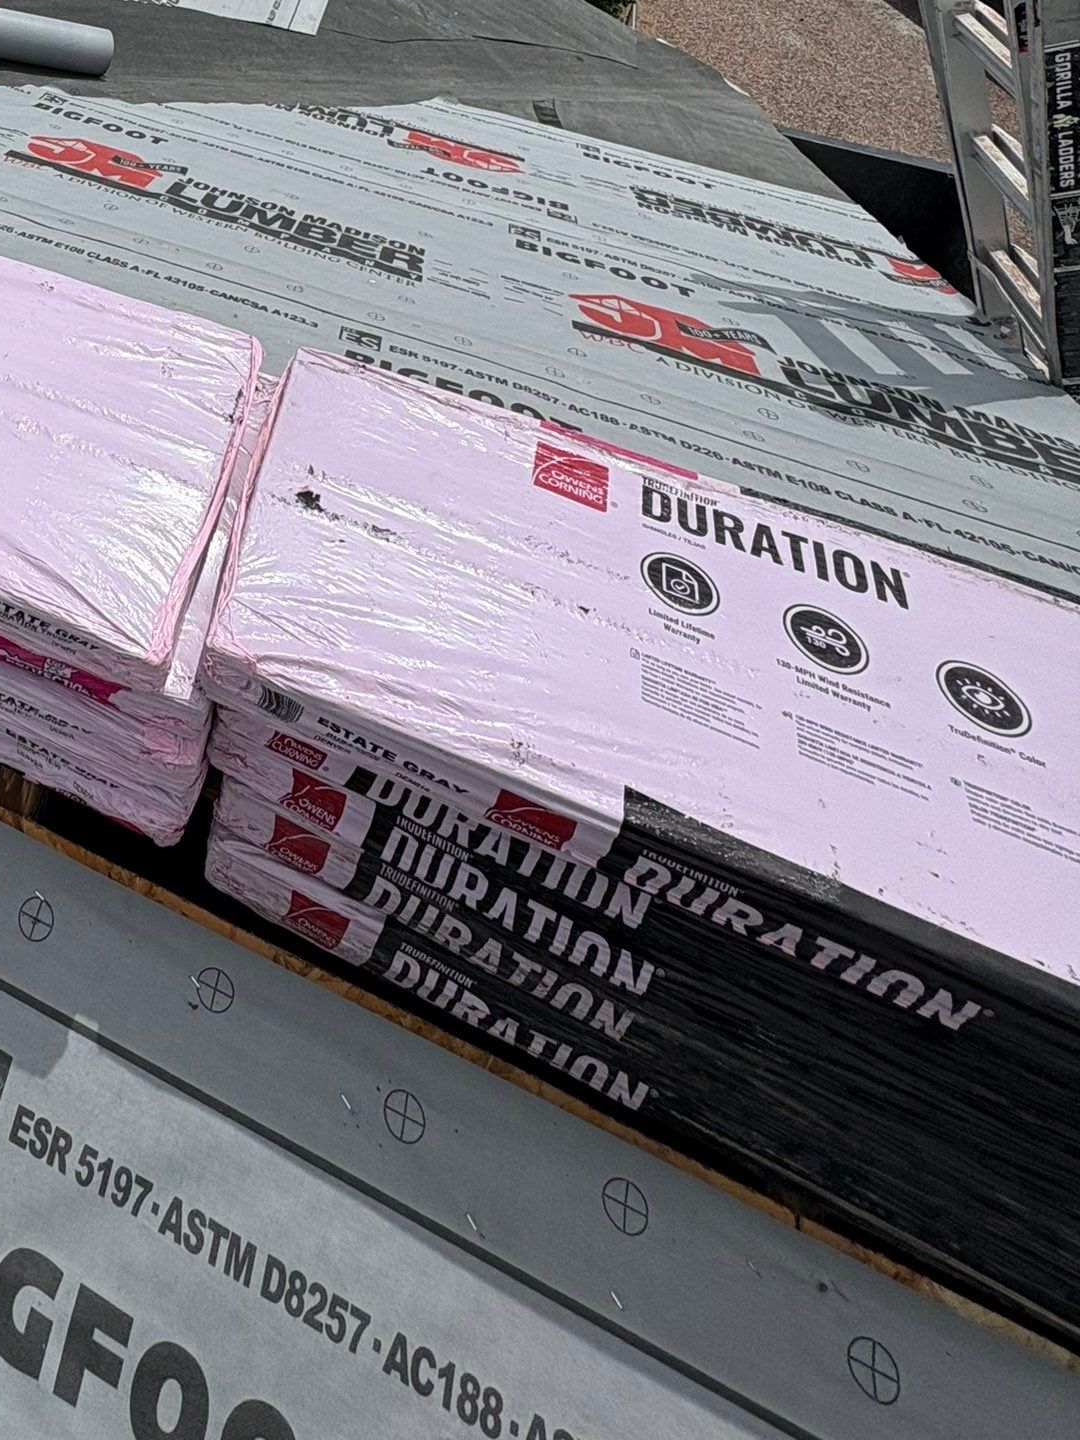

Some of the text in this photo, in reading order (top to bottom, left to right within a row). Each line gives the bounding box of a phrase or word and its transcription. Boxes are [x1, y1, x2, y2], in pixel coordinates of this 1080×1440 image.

[33, 103, 168, 144] BIGFOOT
[1054, 51, 1075, 187] GORILLA LADDERS
[178, 177, 427, 257] JOHNSON MADISON
[421, 168, 569, 211] BIGFOOT
[165, 179, 426, 273] LUMBER
[516, 239, 694, 297] BIGFOOT
[780, 358, 945, 422] JOHNSON
[779, 368, 1080, 472] LUMBE
[539, 472, 605, 506] CORNING
[551, 468, 608, 496] OWENS
[641, 483, 911, 610] DURATION
[648, 607, 716, 640] Limited Lifetime
[663, 622, 701, 645] Warranty
[776, 658, 892, 709] 130-MPH Wind Resistance
[796, 676, 872, 712] Limited Warranty
[272, 740, 320, 769] CORNING
[317, 717, 470, 794] ESTATE GRAY
[1018, 750, 1047, 768] Color
[299, 797, 337, 827] OWENS
[366, 770, 655, 930] DURATION
[379, 826, 657, 998] DURATION
[380, 862, 456, 911] TRUDEFINITION
[363, 874, 637, 1043] DURATION
[400, 942, 475, 988] TRUDEFINITION
[622, 855, 984, 1032] DURATION
[383, 949, 651, 1112] DURATION
[8, 1104, 74, 1176] ESR
